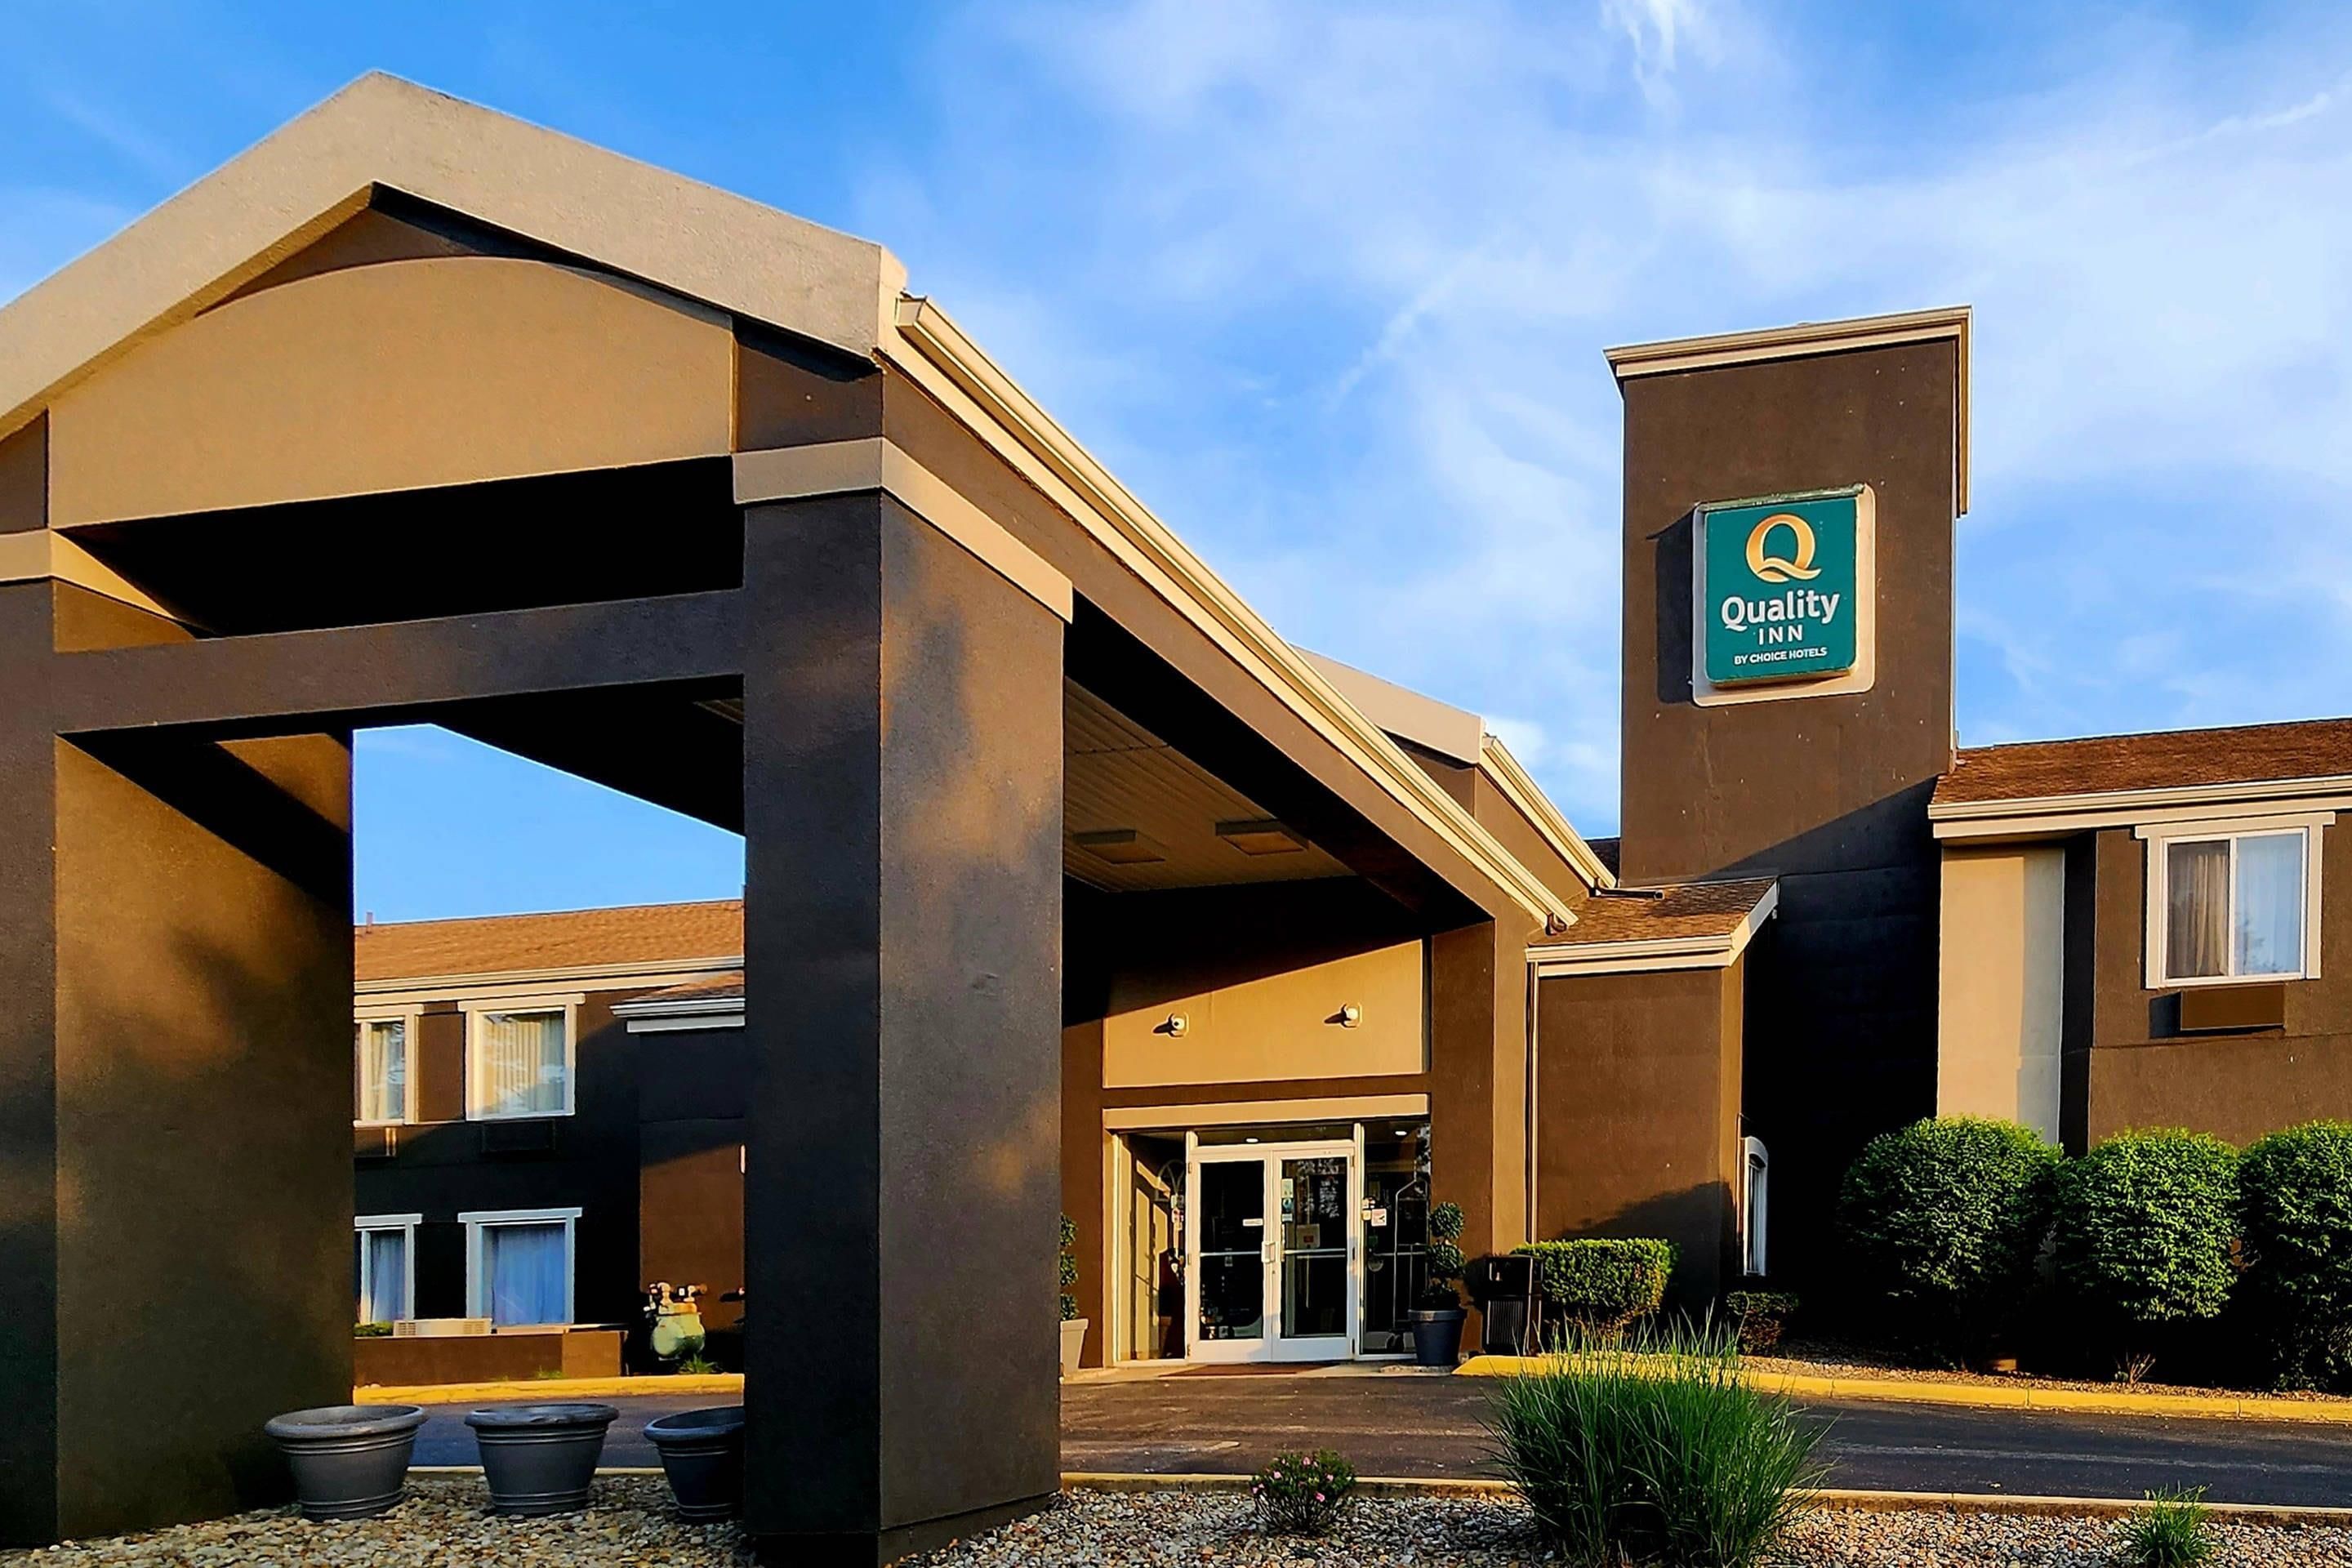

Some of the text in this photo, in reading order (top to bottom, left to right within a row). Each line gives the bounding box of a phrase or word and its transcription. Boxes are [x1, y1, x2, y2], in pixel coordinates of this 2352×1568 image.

[1746, 514, 1822, 582] Q
[1721, 590, 1840, 631] Quality
[1758, 625, 1803, 645] INN
[1734, 647, 1828, 665] BY CHOICE HOTELS
